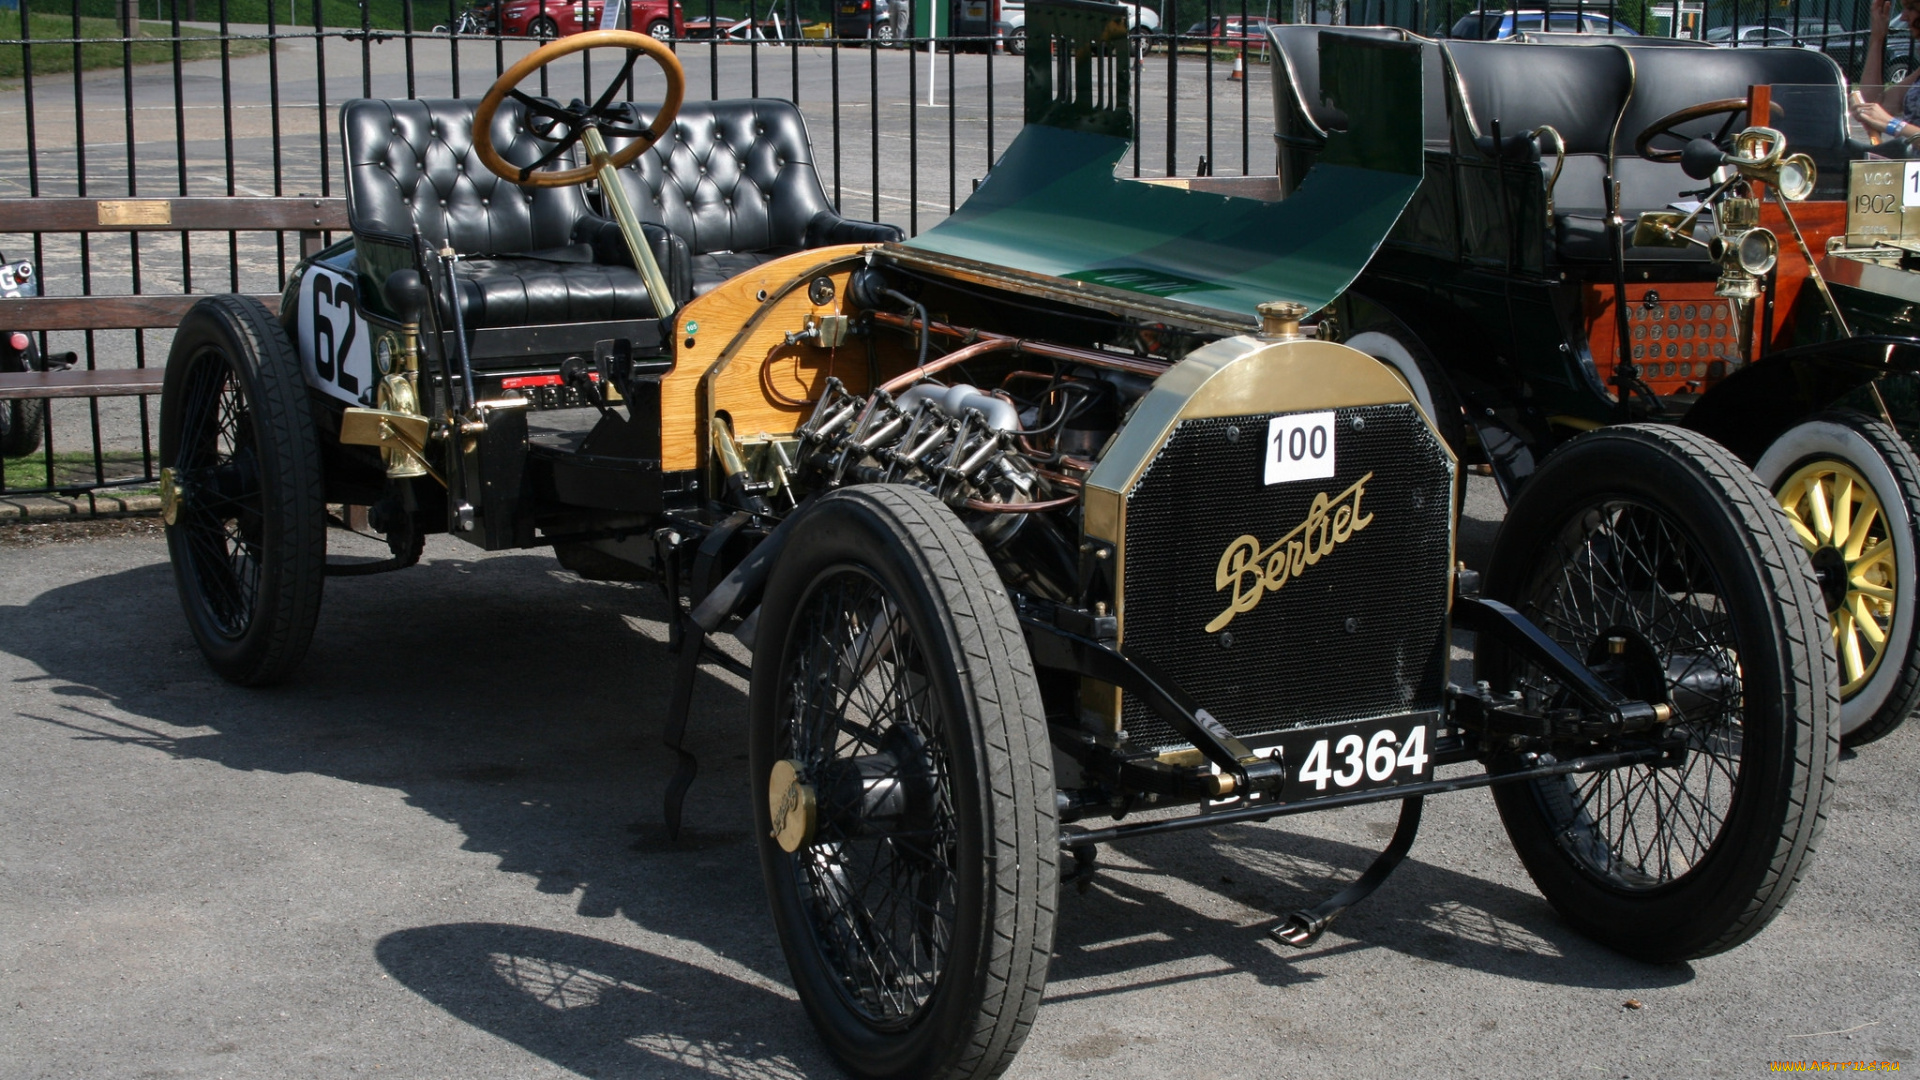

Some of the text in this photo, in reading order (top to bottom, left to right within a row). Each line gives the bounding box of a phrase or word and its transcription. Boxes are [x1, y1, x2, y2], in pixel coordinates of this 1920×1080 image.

[1855, 194, 1896, 214] 1902
[313, 273, 359, 395] 62
[1273, 425, 1327, 463] 100
[1205, 471, 1374, 633] Berliet
[1299, 725, 1428, 790] 4364
